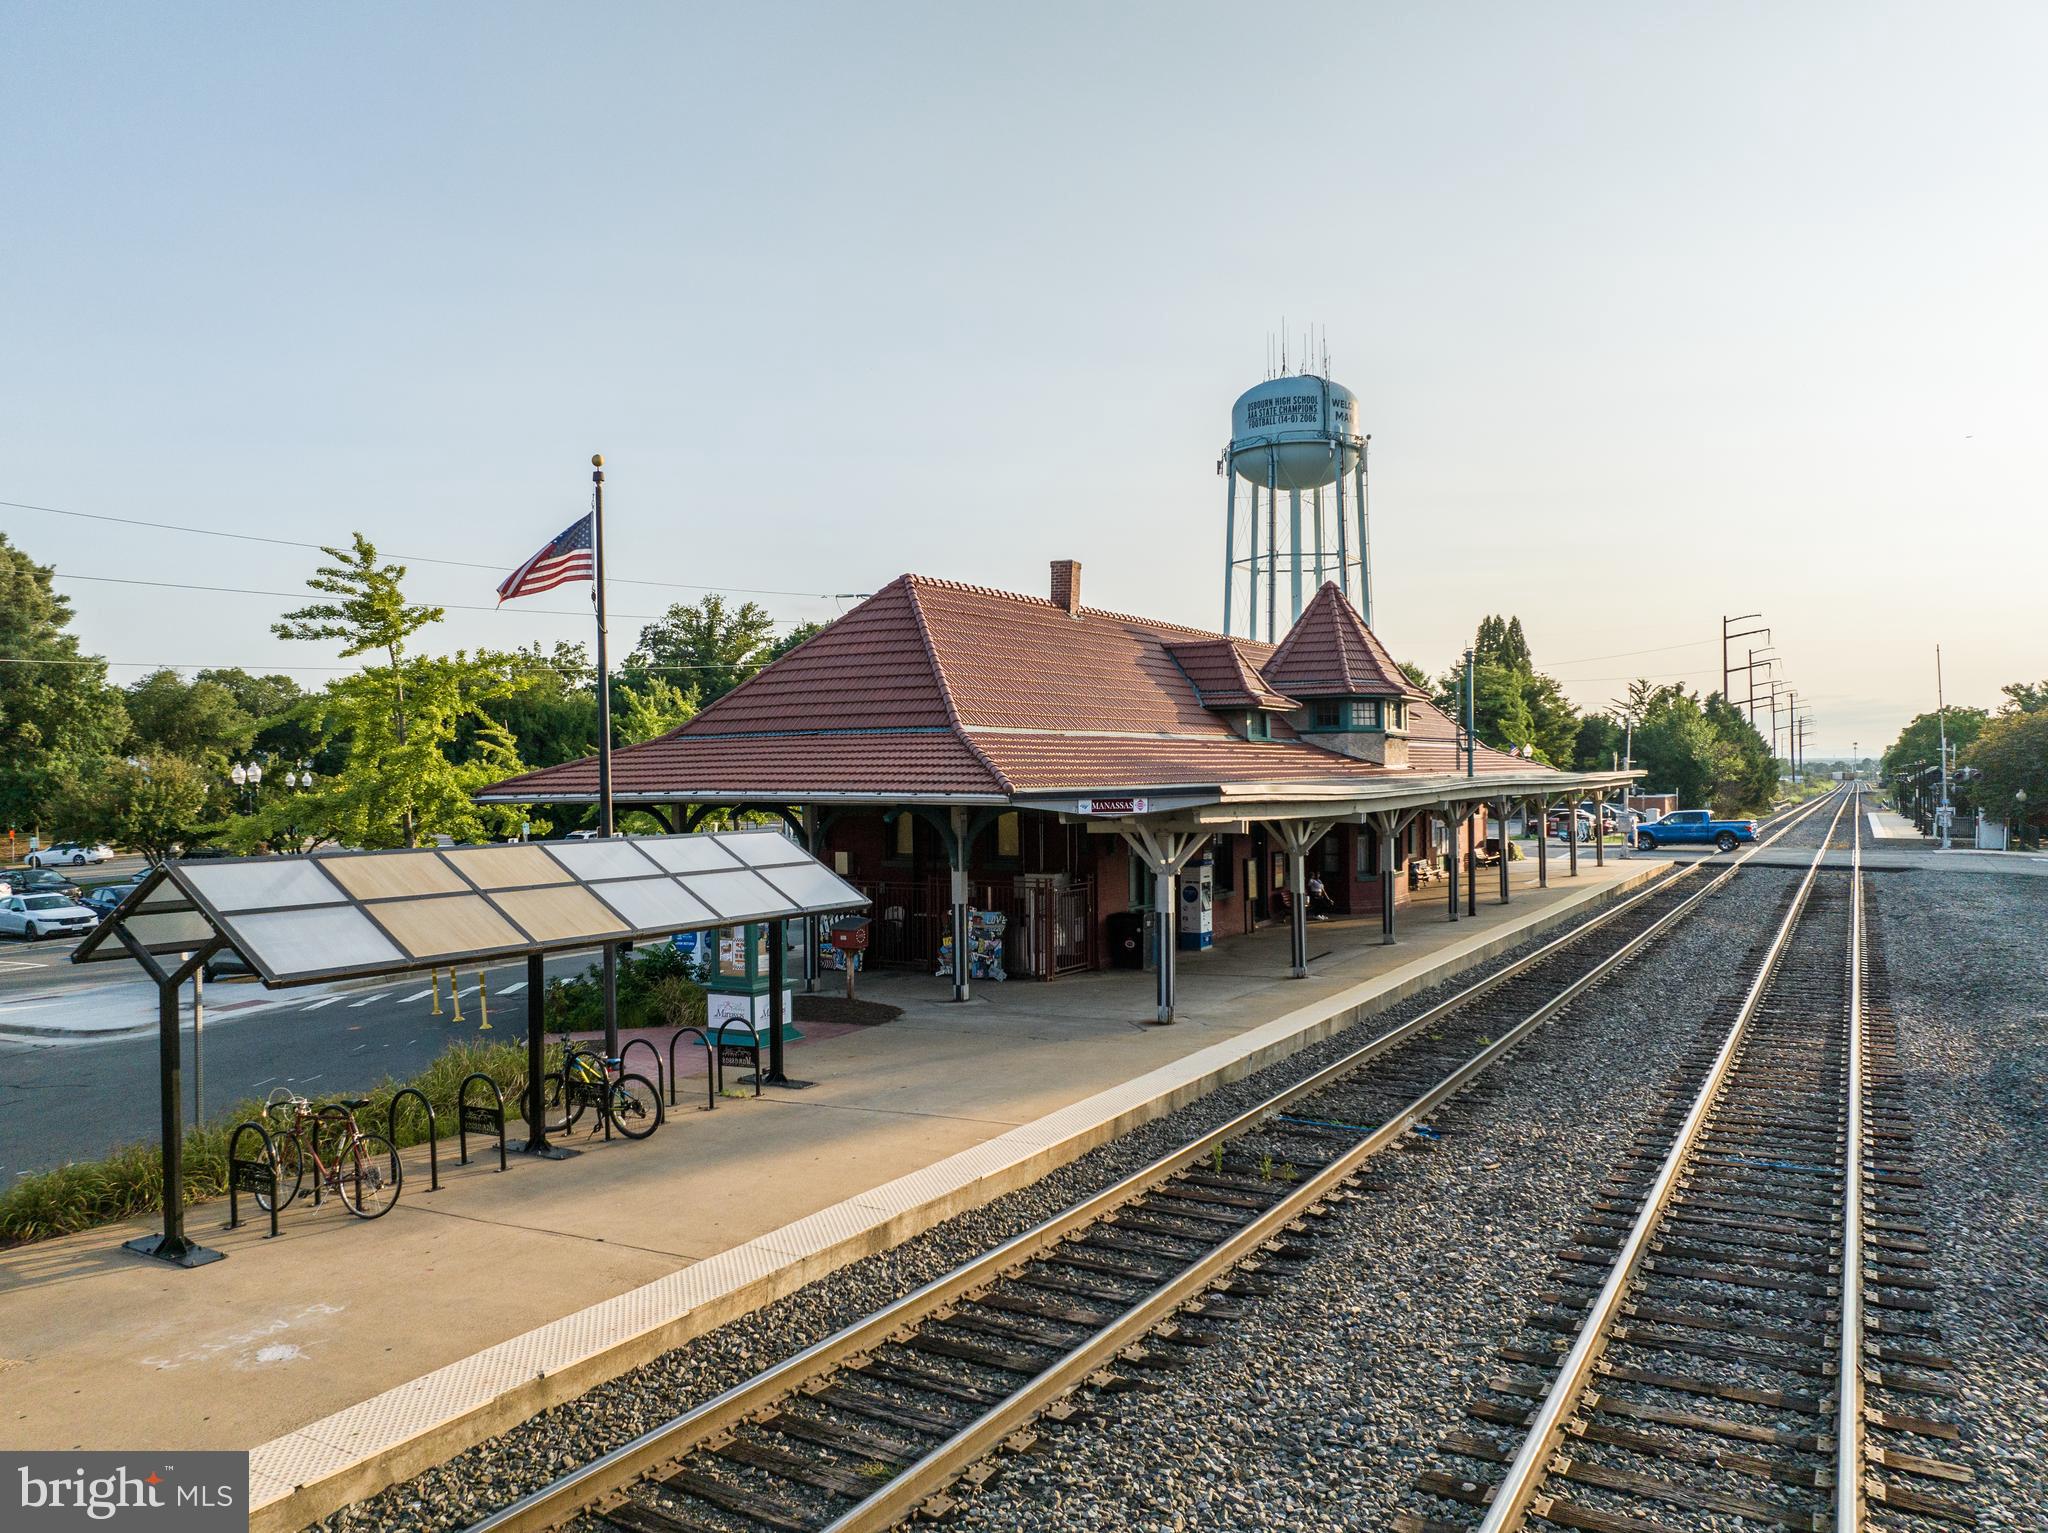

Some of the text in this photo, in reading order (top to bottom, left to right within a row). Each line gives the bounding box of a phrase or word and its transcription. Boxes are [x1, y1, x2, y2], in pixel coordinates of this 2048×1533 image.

[1248, 395, 1318, 411] OSBOURN HIGH SCHOOL
[1248, 405, 1317, 420] AAA STATE CHAMPIONS
[1248, 414, 1317, 429] FOOTBALL (14-0) 2006
[1092, 802, 1133, 810] MANASSAS
